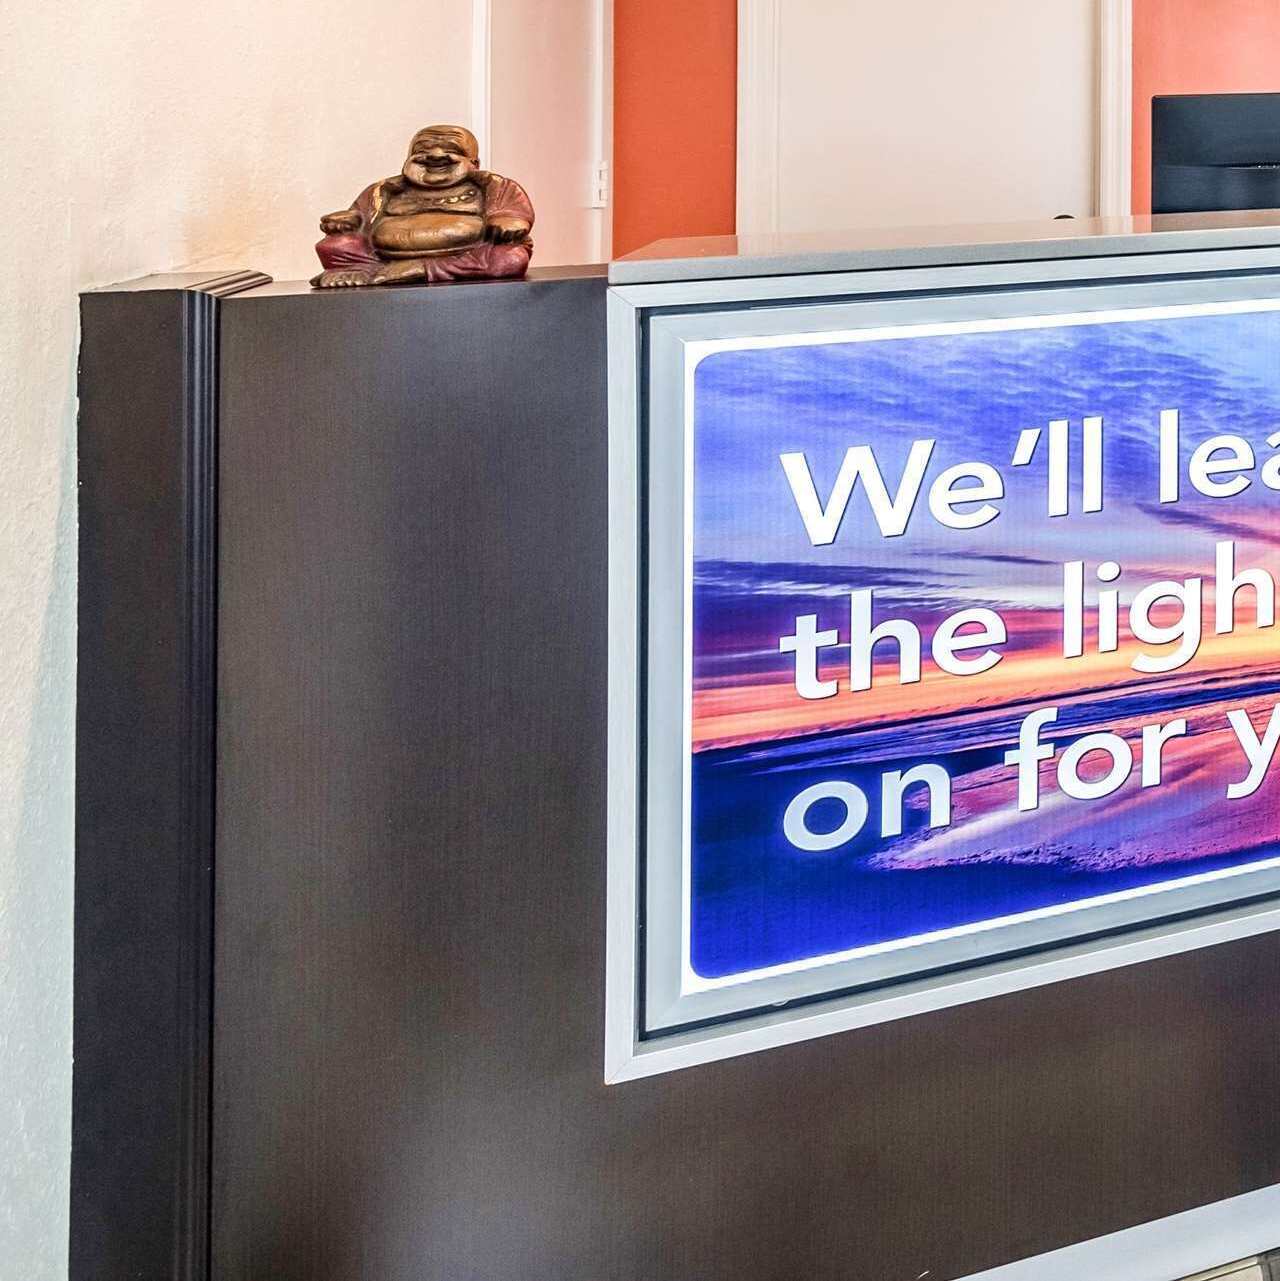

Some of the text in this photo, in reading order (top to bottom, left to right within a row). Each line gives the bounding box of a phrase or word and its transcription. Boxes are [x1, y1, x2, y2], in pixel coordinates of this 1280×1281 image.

[781, 417, 1102, 546] We'll
[780, 590, 1007, 700] the
[783, 763, 952, 850] on
[1004, 708, 1187, 811] for
